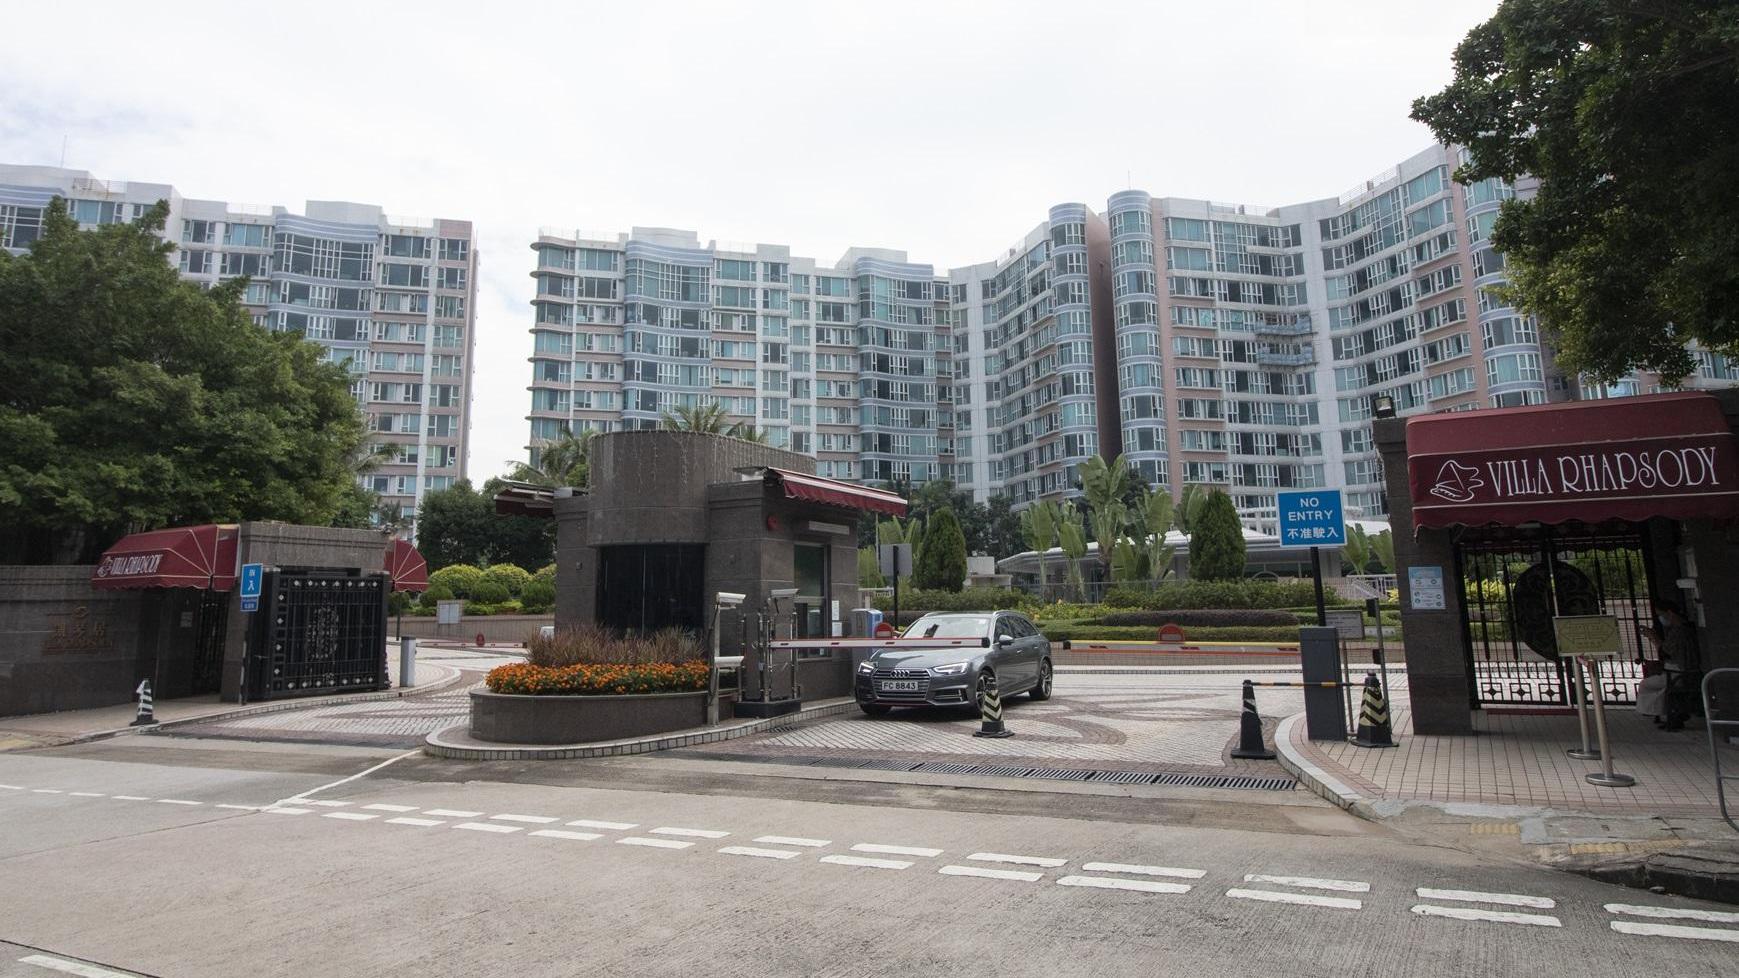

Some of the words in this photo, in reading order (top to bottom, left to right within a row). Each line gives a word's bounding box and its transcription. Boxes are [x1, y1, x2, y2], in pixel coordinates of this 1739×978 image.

[1486, 457, 1554, 497] VILLA
[1556, 446, 1720, 494] RHAPSODY
[1300, 497, 1319, 508] NO
[1288, 509, 1333, 522] ENTRY
[1287, 526, 1339, 540] 不准駛入
[883, 682, 894, 690] FC
[895, 682, 916, 690] 8843
